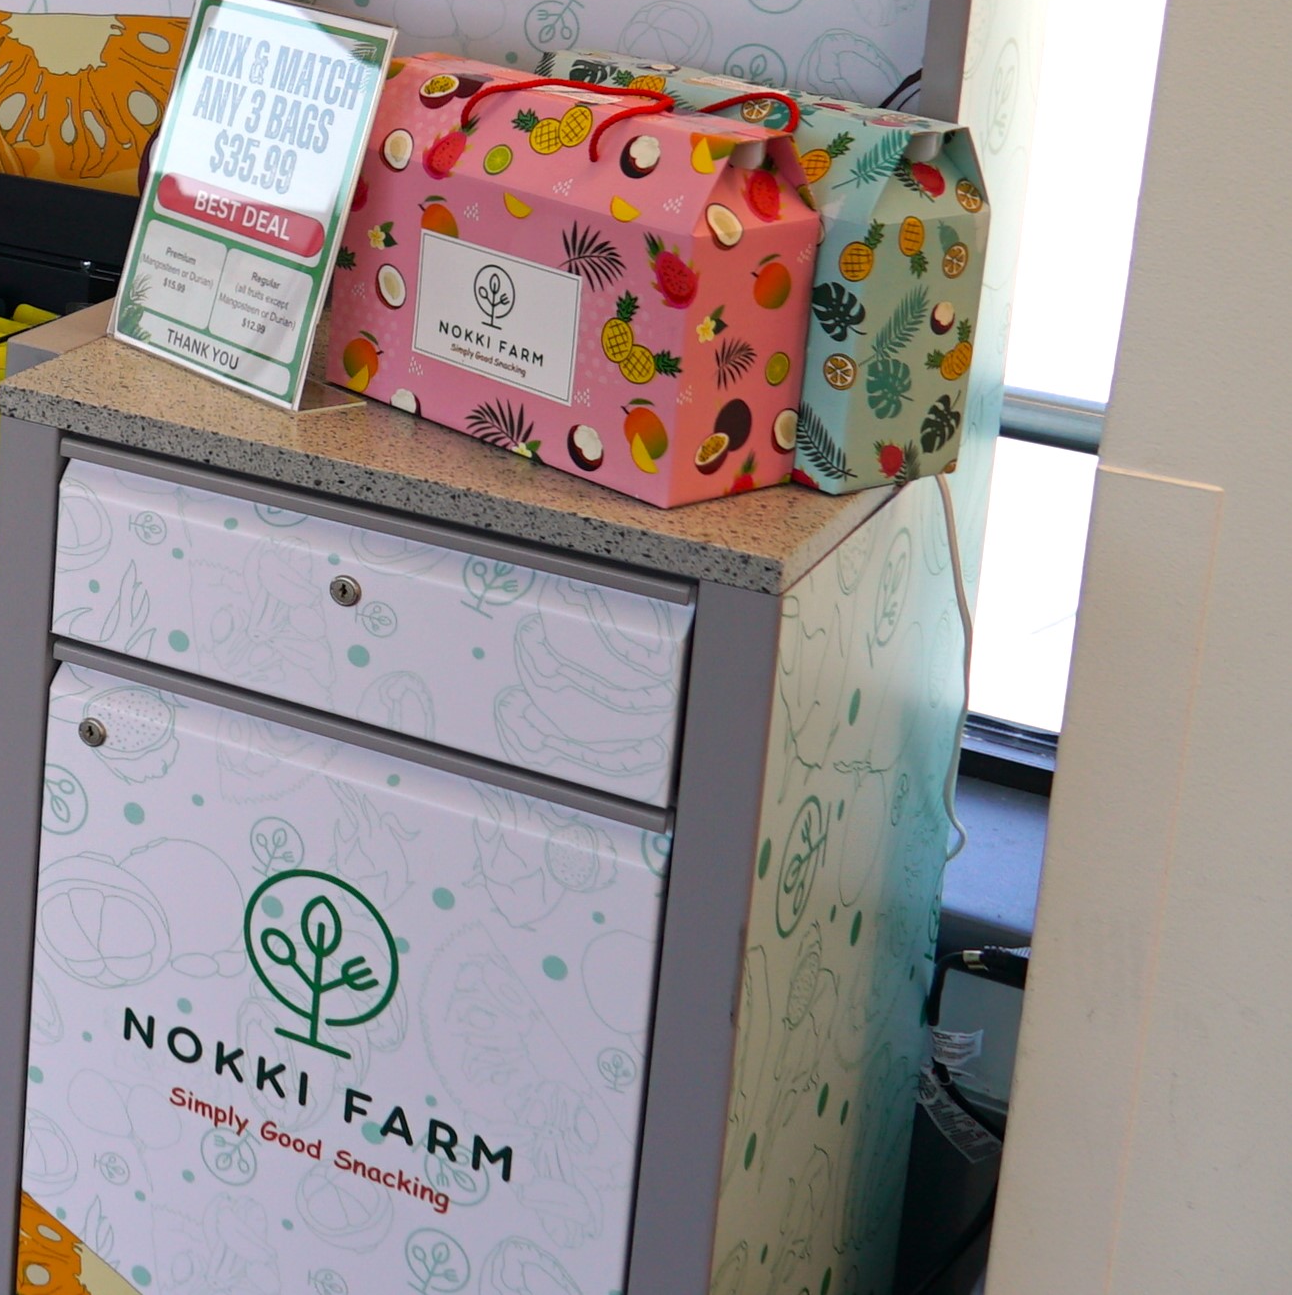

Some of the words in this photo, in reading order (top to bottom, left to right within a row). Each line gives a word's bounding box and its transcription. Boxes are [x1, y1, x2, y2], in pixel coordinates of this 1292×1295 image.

[198, 28, 248, 81] MIX
[249, 40, 270, 85] &
[272, 45, 364, 110] MATCH
[193, 75, 247, 127] ANY
[246, 94, 265, 133] 3
[265, 99, 334, 154] BAGS
[209, 129, 297, 195] $35.99
[195, 189, 240, 221] BEST
[242, 204, 290, 241] DEAL
[167, 247, 196, 265] Premium
[163, 278, 185, 293] $15.99
[182, 269, 189, 278] or
[189, 271, 213, 289] Durian)
[235, 283, 247, 294] (all
[248, 287, 264, 300] fruits
[265, 295, 288, 310] except
[252, 272, 280, 289] Regular
[219, 293, 259, 317] Mangosteen
[270, 312, 296, 331] Durian)
[242, 318, 266, 334] $12.99
[167, 329, 210, 358] THANK
[212, 346, 239, 370] YOU
[439, 320, 490, 349] NOKKI
[499, 341, 543, 367] FARM
[450, 343, 474, 359] Simply
[474, 352, 493, 365] Good
[494, 358, 527, 377] Snacking
[123, 1007, 308, 1106] NOKKI
[344, 1088, 513, 1182] FARM
[169, 1087, 250, 1135] Simply
[260, 1121, 322, 1160] Good
[334, 1151, 449, 1214] Snacking
